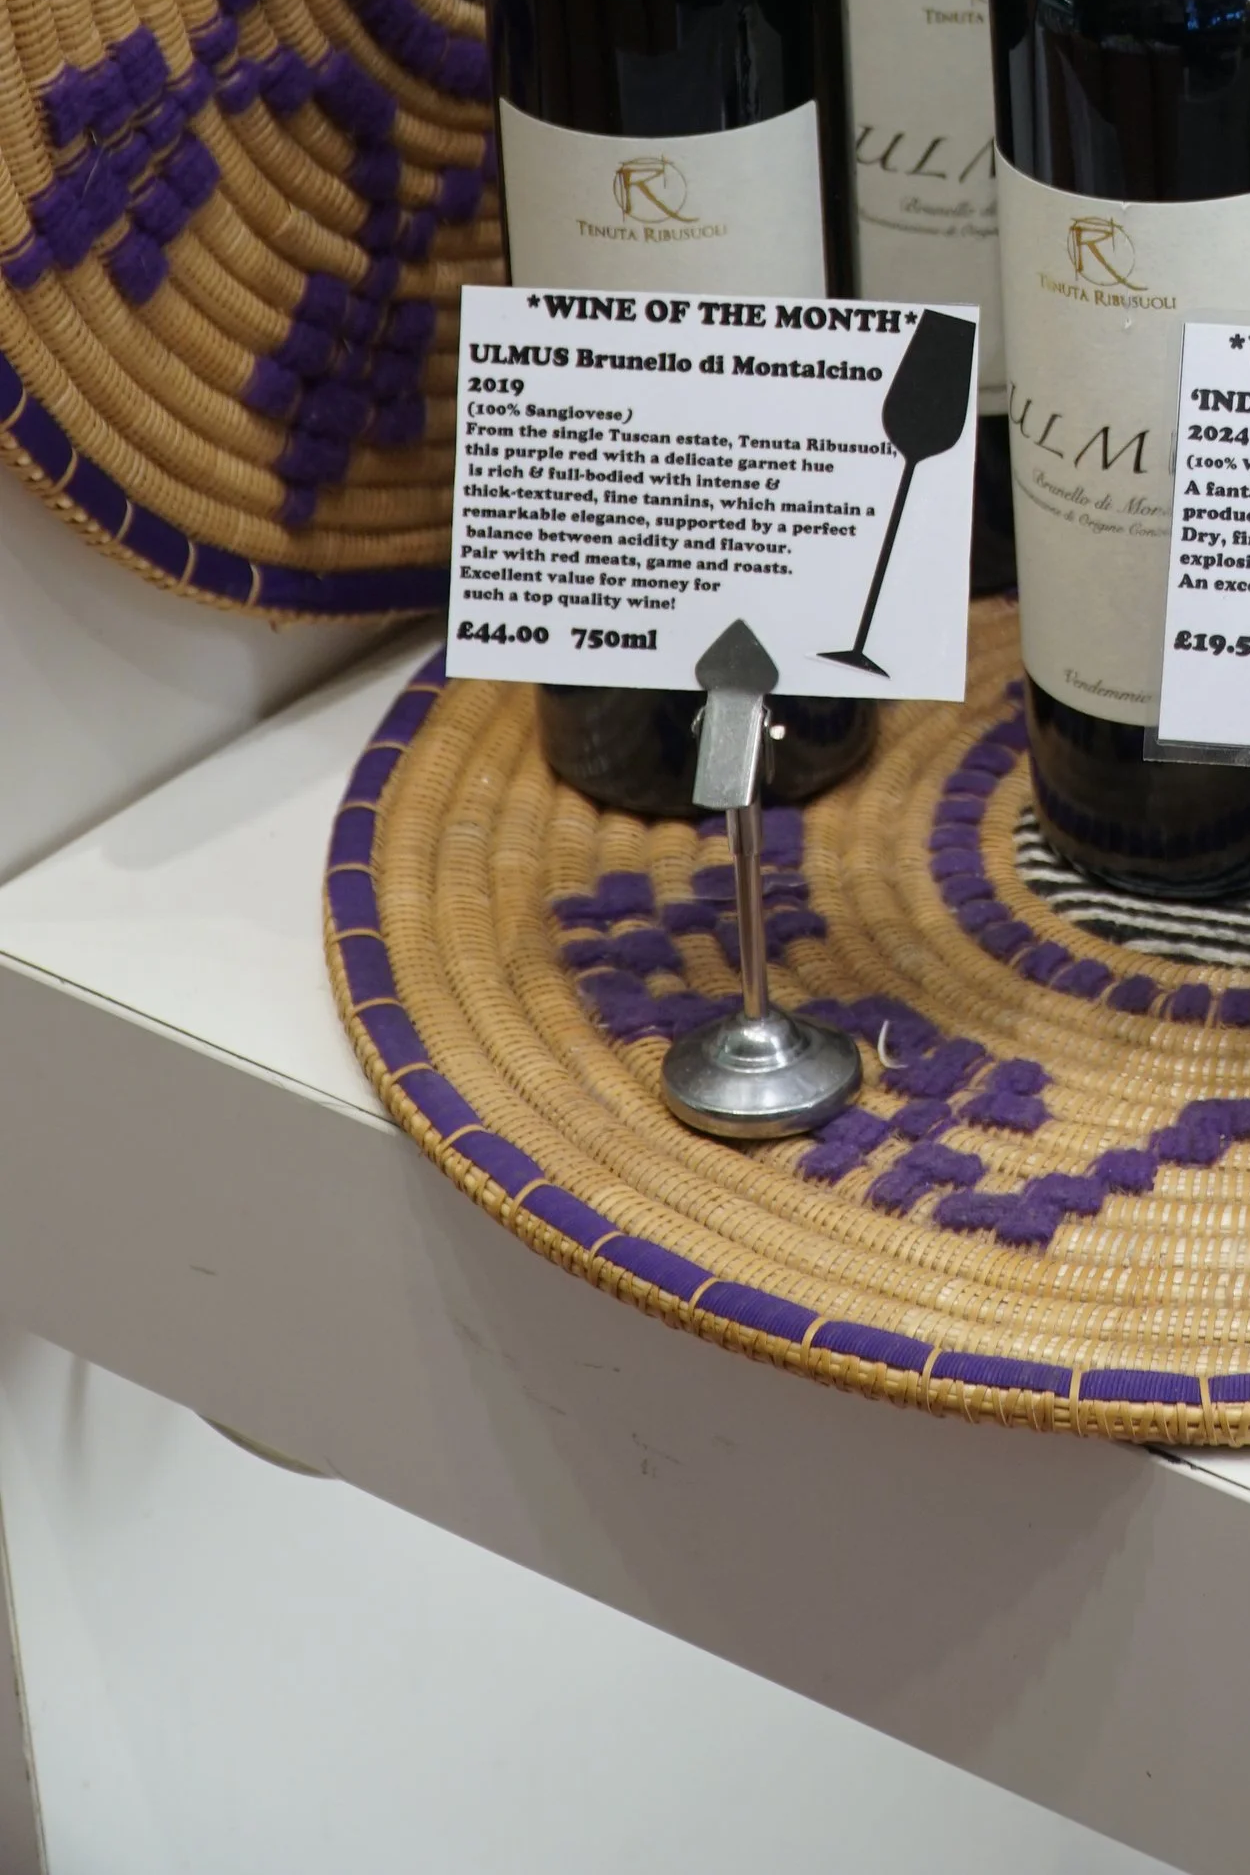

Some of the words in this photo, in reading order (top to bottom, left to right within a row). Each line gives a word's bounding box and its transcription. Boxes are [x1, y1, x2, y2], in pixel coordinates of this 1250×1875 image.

[644, 299, 691, 324] OF
[697, 301, 767, 328] THE
[469, 343, 569, 367] ULMUS
[575, 348, 693, 373] Brunello
[698, 354, 725, 375] di
[731, 355, 883, 382] Montalcino
[468, 376, 525, 397] 2019
[467, 401, 522, 420] (100%
[524, 403, 634, 425] Sangiovese)
[465, 421, 514, 437] From
[519, 424, 548, 439] the
[552, 426, 604, 444] single
[608, 428, 671, 445] Tuscan
[675, 434, 733, 449] estate,
[738, 434, 801, 451] Tenuta
[806, 438, 900, 458] Ribusuoli,
[1187, 424, 1250, 446] 2024
[465, 442, 499, 457] this
[504, 446, 564, 462] purple
[568, 448, 598, 461] red
[602, 449, 646, 464] with
[650, 454, 660, 464] a
[664, 451, 733, 468] delicate
[737, 458, 797, 472] garnet
[801, 458, 835, 473] hue
[1186, 454, 1238, 470] (100%
[468, 463, 483, 477] is
[487, 464, 524, 479] rich
[528, 465, 544, 479] &
[548, 466, 644, 484] full-bodied
[649, 472, 691, 487] with
[696, 473, 761, 490] intense
[765, 477, 781, 491] &
[1183, 479, 1201, 496] A
[463, 483, 599, 505] thick-textured,
[603, 489, 638, 505] fine
[643, 493, 714, 511] tannins,
[719, 496, 776, 512] which
[781, 500, 861, 516] maintain
[865, 506, 875, 517] a
[462, 506, 567, 522] remarkable
[570, 509, 650, 529] elegance,
[655, 516, 746, 531] supported
[751, 518, 773, 535] by
[777, 523, 787, 533] a
[792, 521, 857, 537] perfect
[466, 524, 533, 541] balance
[538, 528, 613, 545] between
[617, 533, 679, 551] acidity
[683, 537, 716, 550] and
[720, 537, 792, 554] flavour.
[1181, 526, 1227, 548] Dry,
[461, 544, 499, 560] Pair
[502, 547, 546, 562] with
[550, 550, 580, 564] red
[585, 554, 641, 569] meats,
[645, 557, 692, 571] game
[696, 558, 729, 572] and
[733, 562, 793, 575] roasts.
[460, 565, 543, 583] Excellent
[547, 570, 595, 585] value
[599, 572, 627, 587] for
[631, 577, 689, 593] money
[693, 577, 721, 592] for
[1178, 573, 1209, 590] An
[463, 587, 505, 601] such
[509, 591, 519, 602] a
[523, 590, 553, 606] top
[557, 592, 622, 610] quality
[626, 595, 676, 610] wine!
[456, 620, 550, 645] £44.00
[570, 627, 657, 651] 750ml
